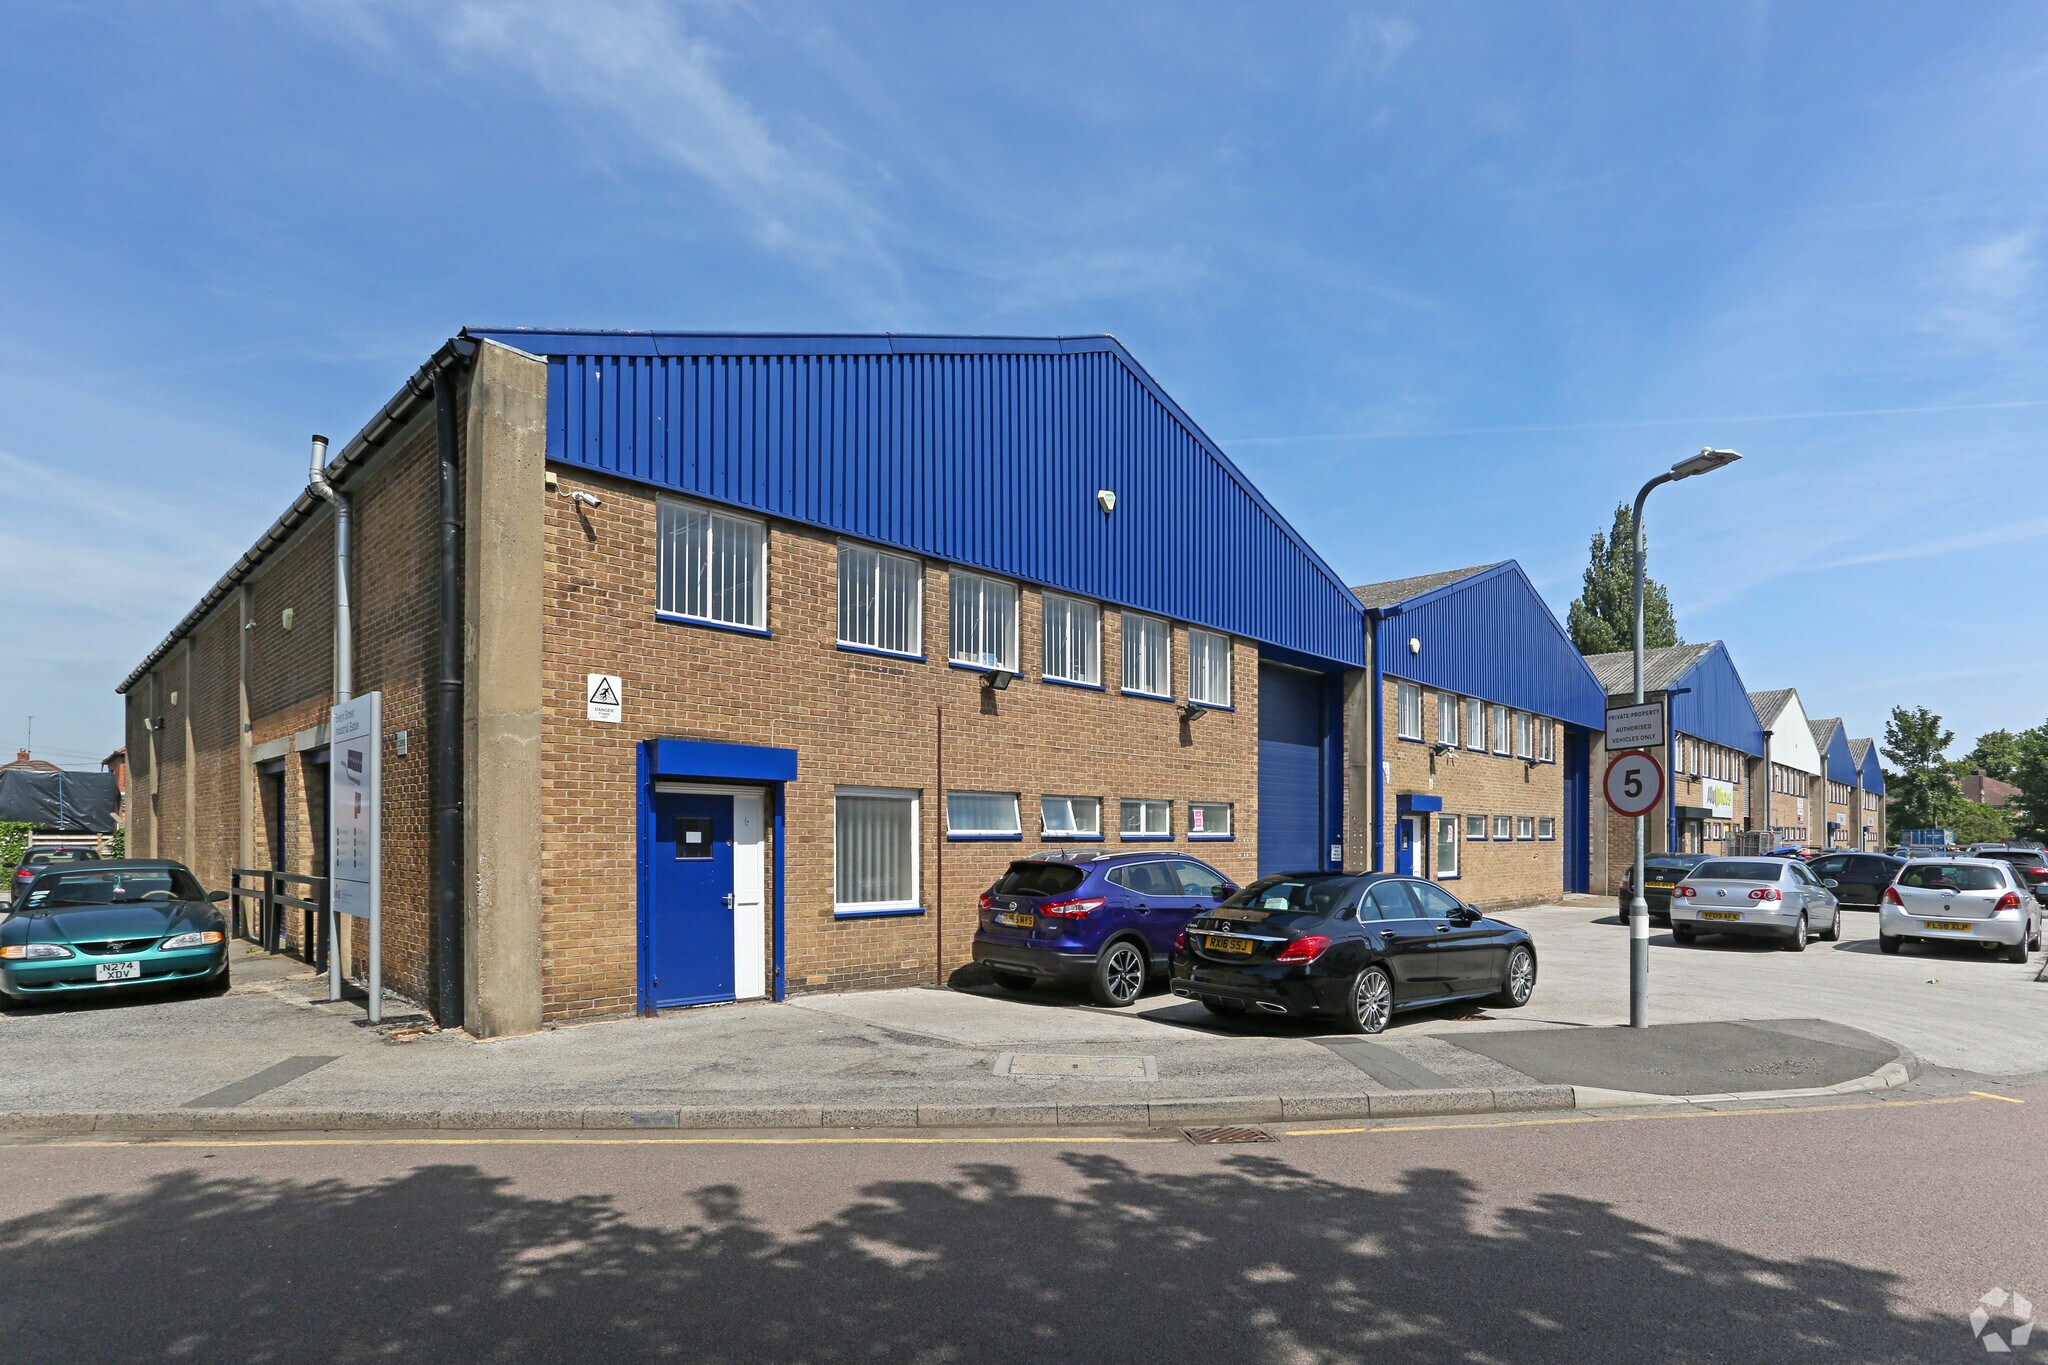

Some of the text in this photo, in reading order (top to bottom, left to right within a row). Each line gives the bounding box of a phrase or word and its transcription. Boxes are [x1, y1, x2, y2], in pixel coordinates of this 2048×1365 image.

[1608, 709, 1660, 720] PRIVATE PROPERTY
[1616, 723, 1652, 733] AUTHORISED
[1612, 733, 1656, 743] VEHICLES ONLY
[1624, 768, 1643, 798] 5
[1210, 937, 1248, 951] RX16 SSJ
[103, 962, 133, 971] N274
[107, 970, 130, 979] XDV
